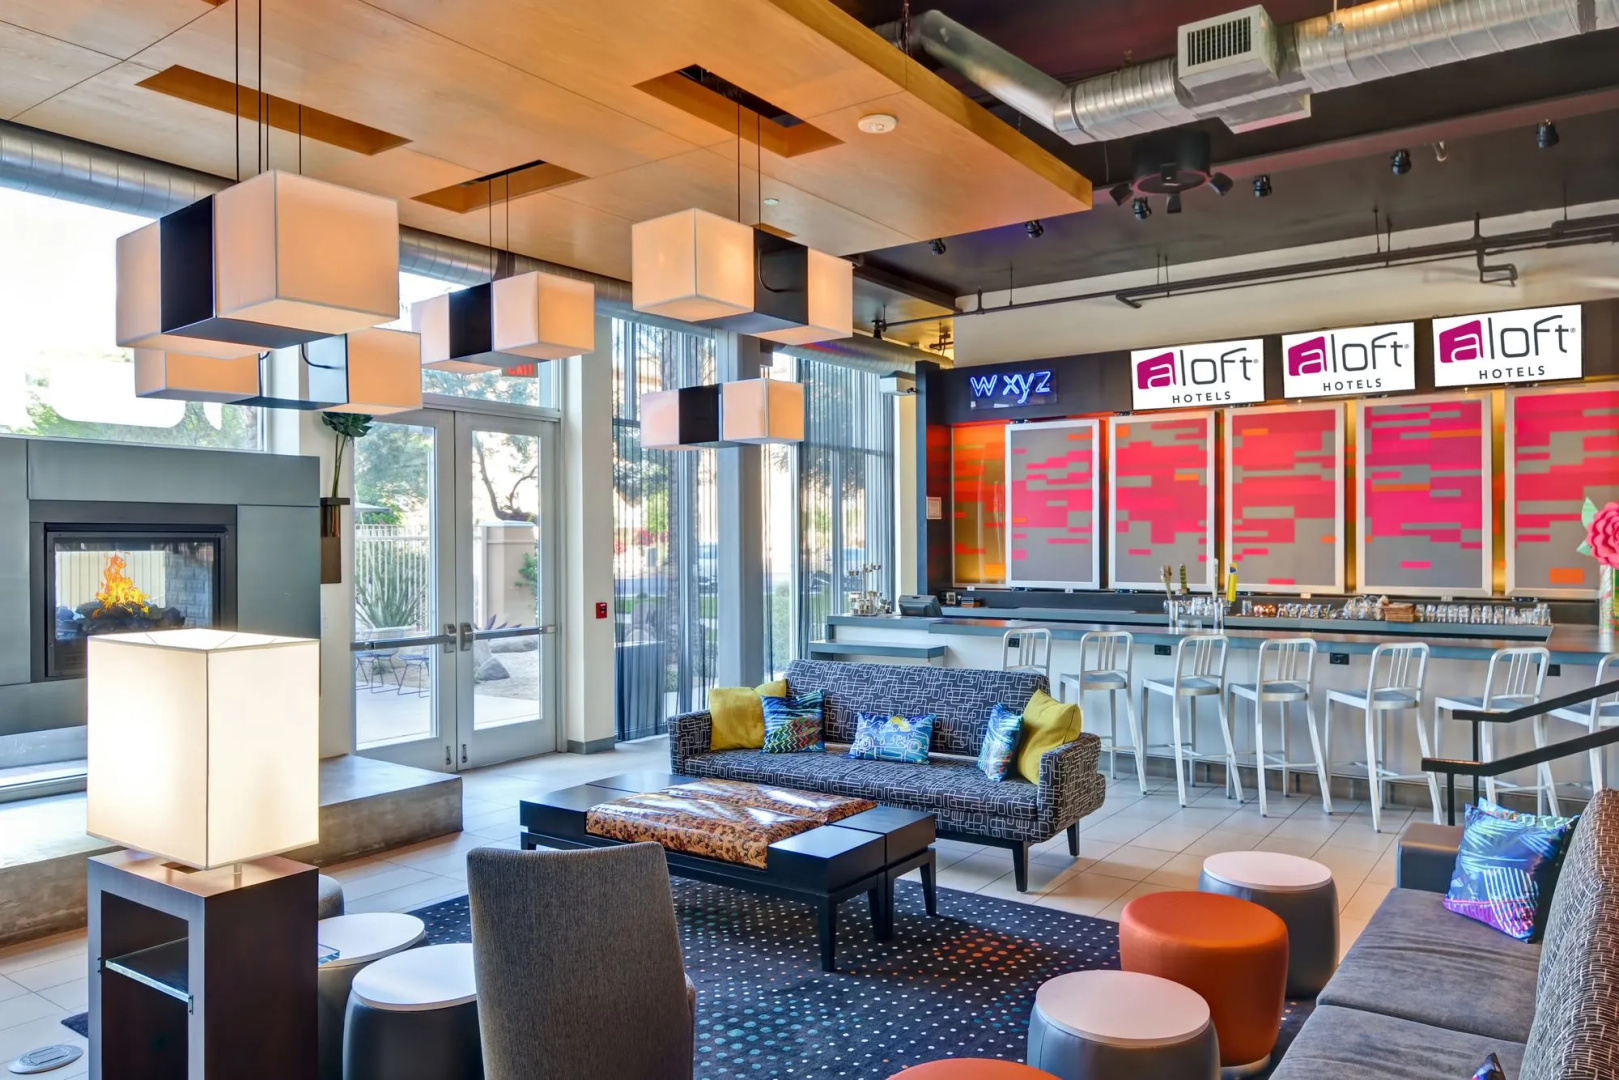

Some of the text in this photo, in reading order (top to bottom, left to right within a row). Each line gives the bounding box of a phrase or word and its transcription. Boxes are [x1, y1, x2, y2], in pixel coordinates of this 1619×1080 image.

[1438, 315, 1569, 363] aloft
[1288, 332, 1404, 376] aloft
[1137, 348, 1253, 389] aloft
[1479, 365, 1545, 380] HOTELS
[1172, 391, 1231, 404] HOTELS
[1323, 378, 1382, 392] HOTELS
